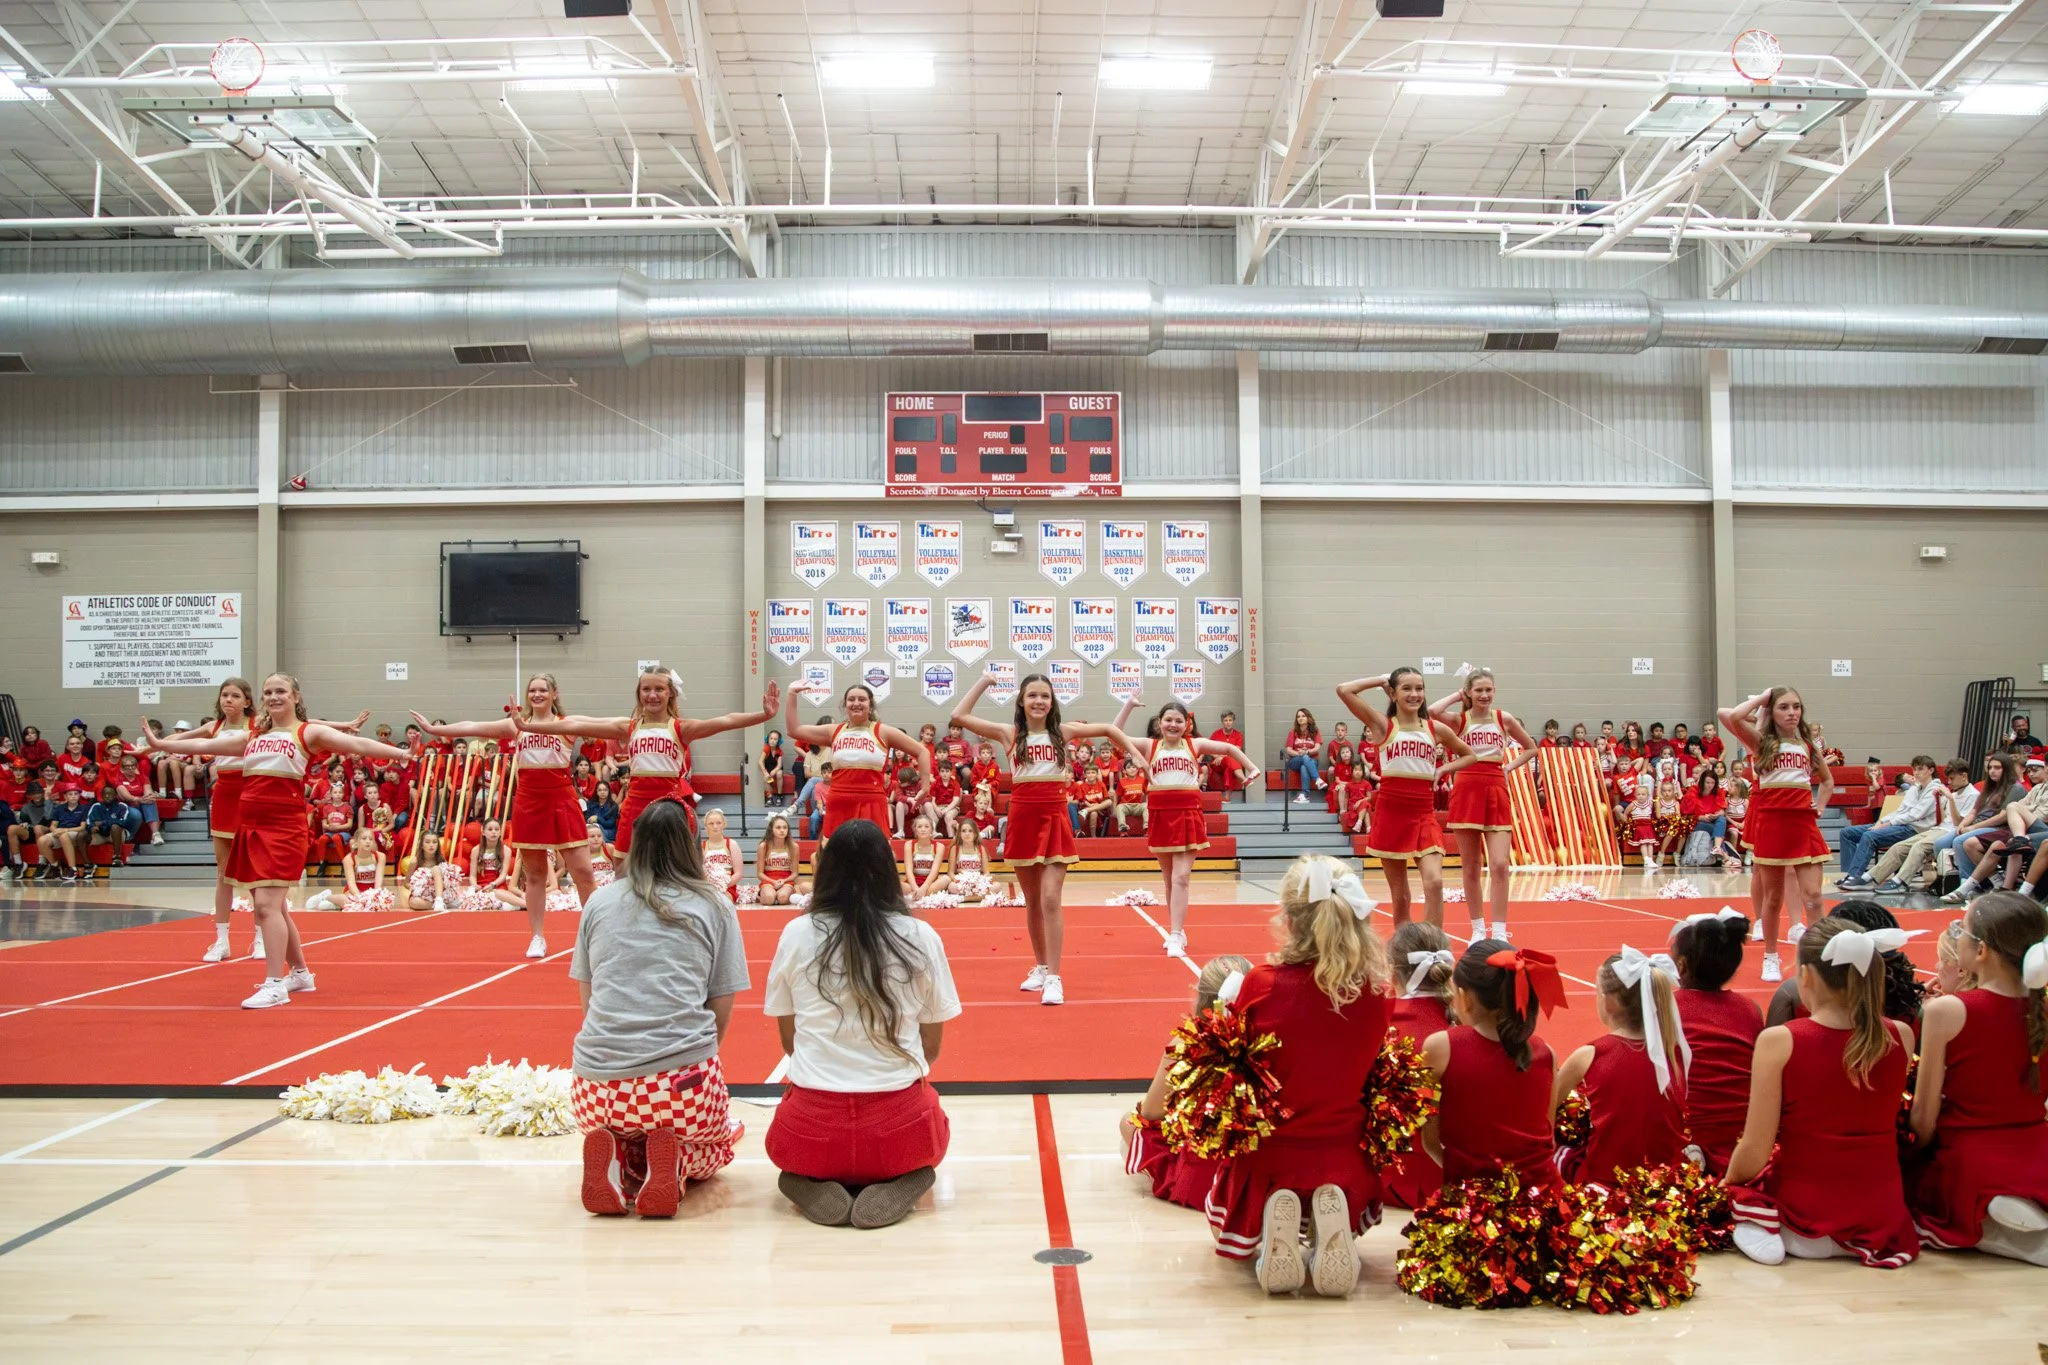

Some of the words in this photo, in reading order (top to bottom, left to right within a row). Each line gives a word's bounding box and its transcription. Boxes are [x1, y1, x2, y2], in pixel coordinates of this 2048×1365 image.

[895, 396, 934, 411] HOME
[1069, 396, 1113, 411] GUEST
[983, 431, 1008, 439] PERIOD
[895, 447, 917, 455] FOULS
[940, 447, 958, 455] T.O.L.
[979, 447, 1004, 455] PLAYER
[1011, 447, 1028, 455] FOUL
[1049, 447, 1068, 455] T.O.L.
[1090, 447, 1111, 455] FOULS
[895, 474, 917, 482] SCORE
[992, 474, 1016, 482] MATCH
[1089, 474, 1112, 482] SCORE
[889, 486, 938, 496] Scoreboard
[940, 486, 974, 496] Donated
[976, 486, 990, 498] by
[992, 486, 1022, 496] Electra
[1101, 486, 1118, 496] Inc.
[858, 549, 897, 558] VOLLEYBALL
[918, 548, 958, 557] VOLLEYBALL
[1042, 548, 1082, 557] VOLLEYBALL
[1104, 549, 1144, 557] BASKETBALL
[795, 557, 836, 567] CHAMPIONS
[857, 557, 897, 567] CHAMPION
[918, 556, 958, 566] CHAMPION
[1042, 556, 1082, 566] CHAMPION
[1104, 557, 1144, 566] RUNNERUP
[1166, 555, 1205, 565] CHAMPION
[805, 568, 826, 578] 2018
[928, 567, 949, 575] 2020
[1052, 567, 1073, 575] 2021
[1113, 567, 1134, 575] 2021
[1175, 567, 1195, 575] 2021
[869, 573, 887, 581] 2018
[88, 597, 135, 609] ATHLETICS
[137, 596, 160, 609] CODE
[162, 596, 173, 608] OF
[175, 595, 217, 608] CONDUCT
[770, 627, 809, 636] VOLLEYBALL
[826, 627, 866, 636] BASKETBALL
[888, 626, 928, 635] BASKETBALL
[1012, 625, 1053, 634] TENNIS
[1074, 625, 1114, 634] VOLLEYBALL
[1135, 626, 1174, 635] VOLLEYBALL
[1207, 626, 1230, 634] GOLF
[749, 610, 760, 675] WARRIORS
[769, 635, 810, 645] CHAMPION
[826, 635, 866, 645] CHAMPIONS
[888, 634, 928, 644] CHAMPIONS
[1012, 633, 1052, 643] CHAMPION
[1074, 633, 1114, 643] CHAMPION
[1135, 634, 1175, 643] CHAMPION
[1199, 633, 1239, 643] CHAMPION
[1248, 608, 1258, 672] WARRIORS
[897, 644, 919, 653] 2022
[949, 639, 989, 649] CHAMPION
[1022, 643, 1043, 652] 2023
[1083, 643, 1105, 652] 2023
[1144, 644, 1166, 652] 2024
[1208, 644, 1229, 652] 2025
[779, 645, 801, 654] 2022
[835, 645, 857, 654] 2022
[176, 677, 211, 685] ENVIRONMENT
[1152, 757, 1195, 777] WARRIORS
